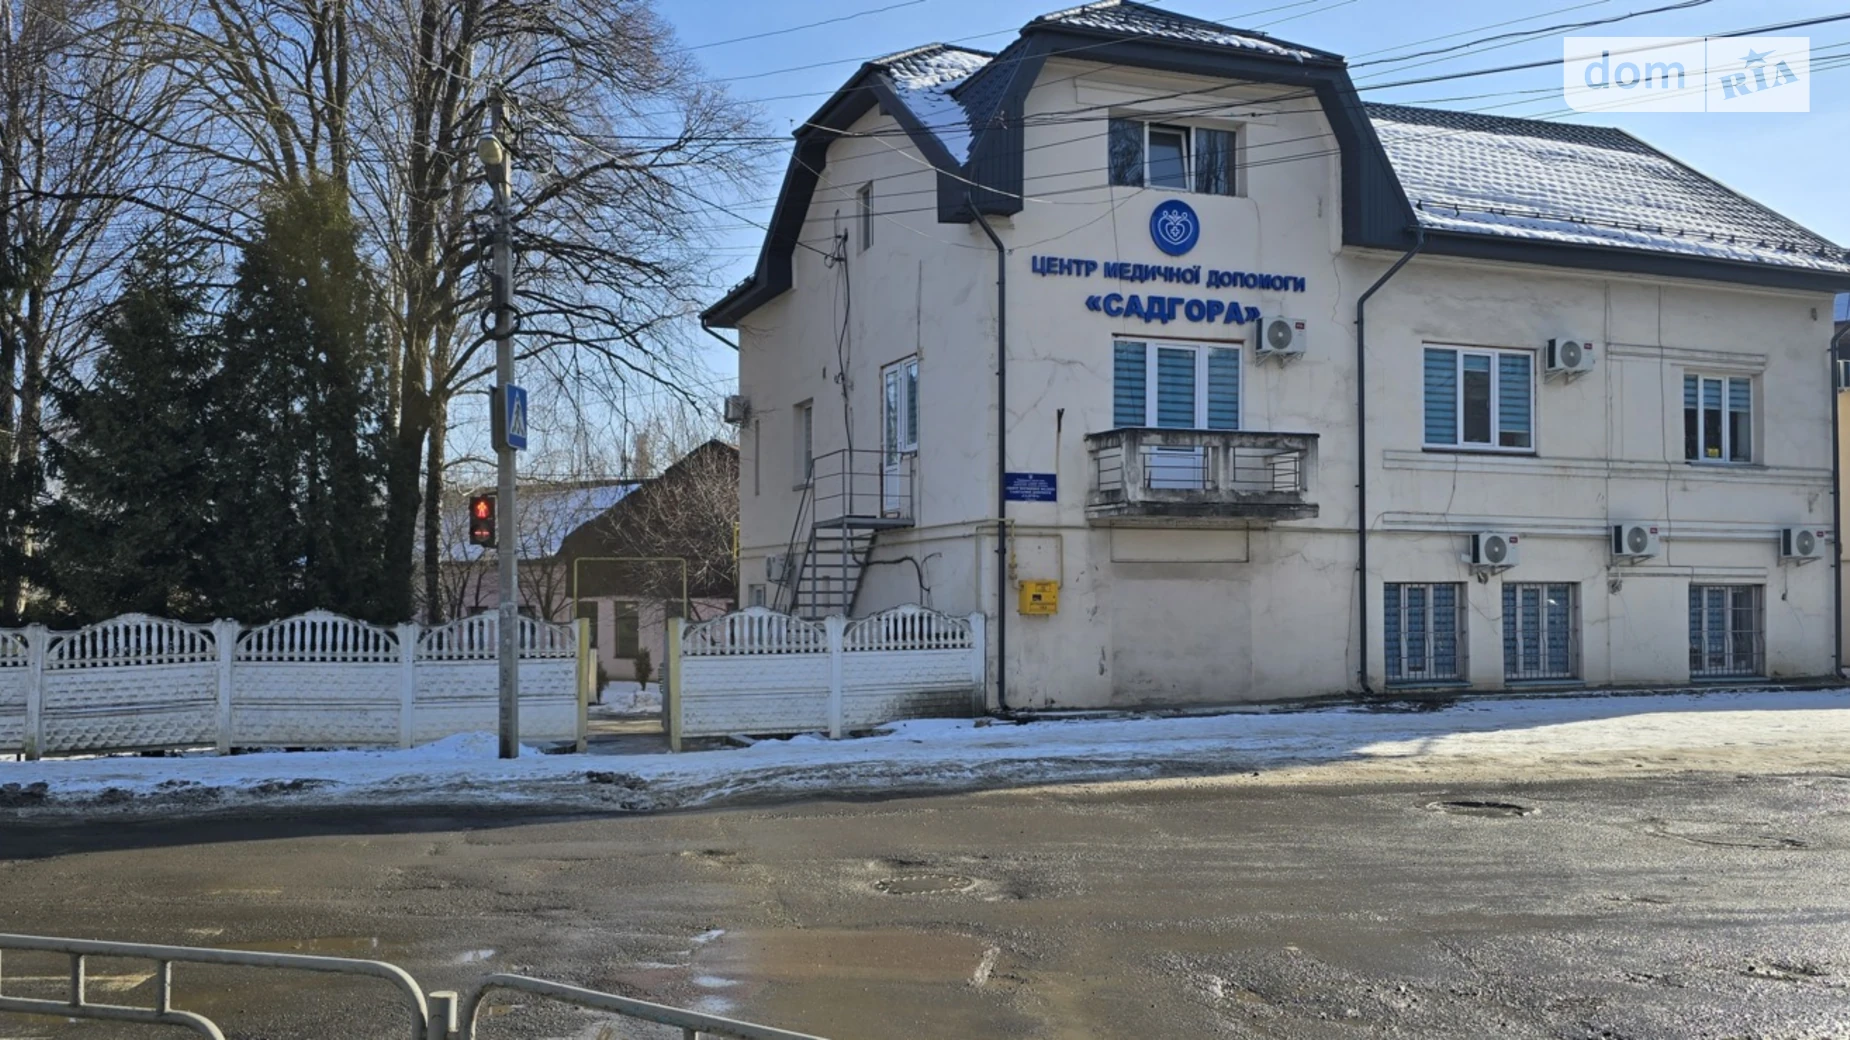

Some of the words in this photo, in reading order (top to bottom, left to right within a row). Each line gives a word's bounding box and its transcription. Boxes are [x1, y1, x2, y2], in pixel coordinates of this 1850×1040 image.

[1031, 255, 1098, 276] ЦЕНТР
[1103, 262, 1201, 284] МЕДИЧНОЇ
[1206, 269, 1306, 292] ДОПОМОГИ
[1085, 293, 1261, 324] «САДГОРА»
